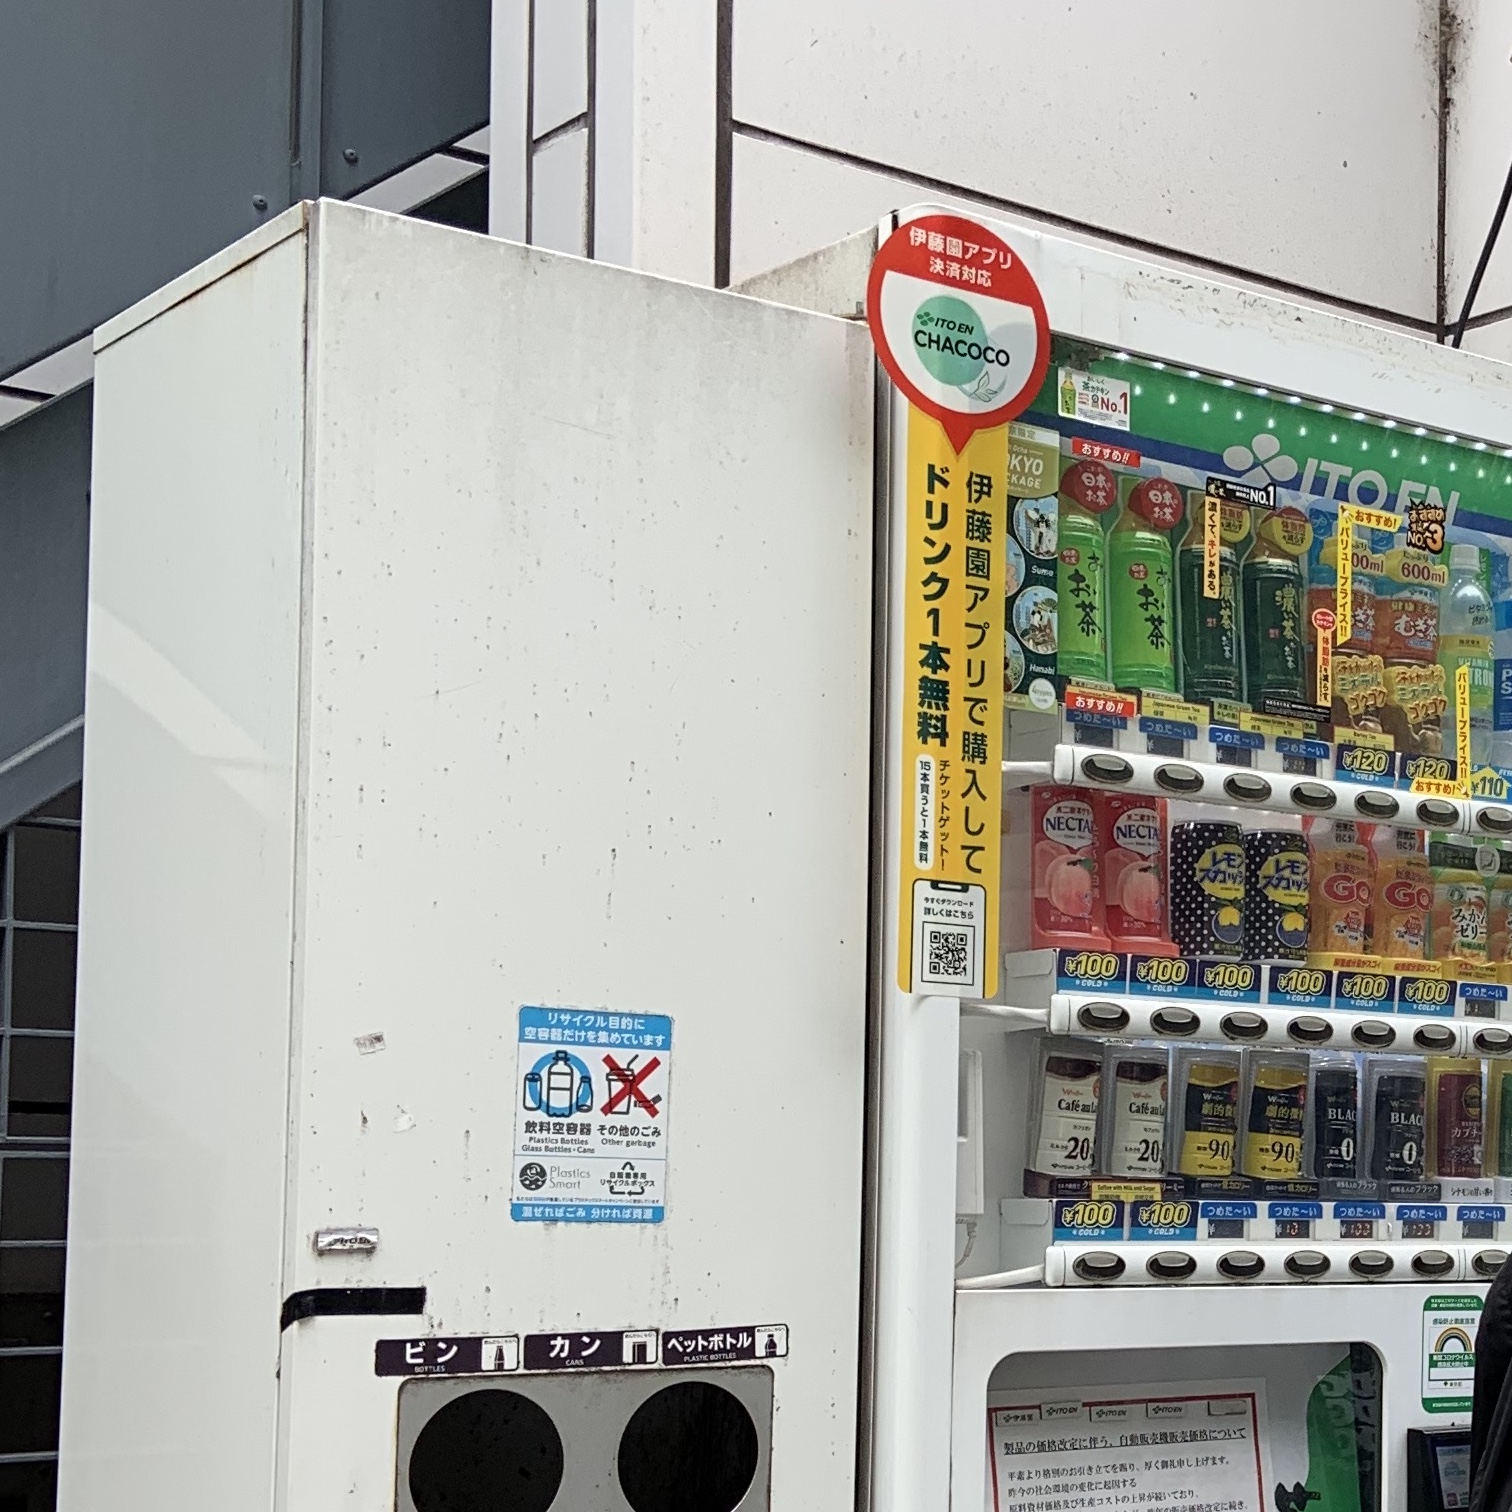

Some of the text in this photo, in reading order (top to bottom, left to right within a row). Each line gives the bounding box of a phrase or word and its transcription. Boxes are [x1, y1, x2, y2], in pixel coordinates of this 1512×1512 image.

[909, 226, 1012, 269] 伊藤園アプリ
[929, 256, 992, 287] 決済対応
[935, 317, 974, 335] ITO EN
[914, 329, 1010, 367] CHACOCO
[1100, 391, 1128, 415] No.1
[1008, 453, 1043, 475] KYO
[1301, 457, 1388, 510] ITO
[1401, 562, 1446, 584] 600ml
[916, 462, 951, 748] ドリンク1本無料
[1068, 569, 1102, 637] お茶
[1136, 584, 1171, 649] お茶
[960, 471, 993, 875] 伊藤園アプリで購入して
[1344, 749, 1388, 774] ¥120
[1406, 758, 1450, 781] ¥120
[918, 760, 932, 865] 15本買うと1本無料
[923, 896, 974, 907] 今すぐダウンロード
[923, 906, 974, 919] 詳しくはこちら
[1066, 954, 1118, 977] ¥100
[1138, 960, 1187, 983] ¥100
[1206, 966, 1252, 988] ¥100
[1279, 971, 1325, 994] ¥100
[1343, 976, 1387, 998] ¥100
[1406, 981, 1449, 1003] ¥100
[548, 1012, 646, 1030] リサイクル目的に
[523, 1026, 666, 1047] 空容器だけを集めています
[1057, 1099, 1091, 1113] Café au
[1129, 1102, 1159, 1116] Café au
[524, 1120, 661, 1138] 飲料空容器 その他のごみ
[529, 1136, 558, 1144] Plastics
[601, 1138, 656, 1148] Other garbage
[1065, 1137, 1090, 1160] 20
[1138, 1139, 1160, 1163] 20
[1209, 1139, 1230, 1160] 90
[1271, 1141, 1295, 1163] 90
[1341, 1138, 1354, 1160] 0
[1402, 1142, 1417, 1164] 0
[550, 1165, 591, 1178] Plastics
[549, 1178, 581, 1190] Smart
[600, 1179, 655, 1187] リサイクルボックス
[522, 1206, 653, 1219] 混ぜればごみ 分ければ資源
[1063, 1203, 1116, 1226] ¥100
[1140, 1203, 1191, 1227] ¥100
[405, 1342, 458, 1364] ビン
[549, 1336, 601, 1359] カン
[667, 1331, 753, 1354] ペットボトル
[415, 1365, 446, 1373] BOTTLES
[565, 1358, 584, 1366] CANS
[1055, 1407, 1067, 1416] ITO
[1104, 1410, 1116, 1418] ITO
